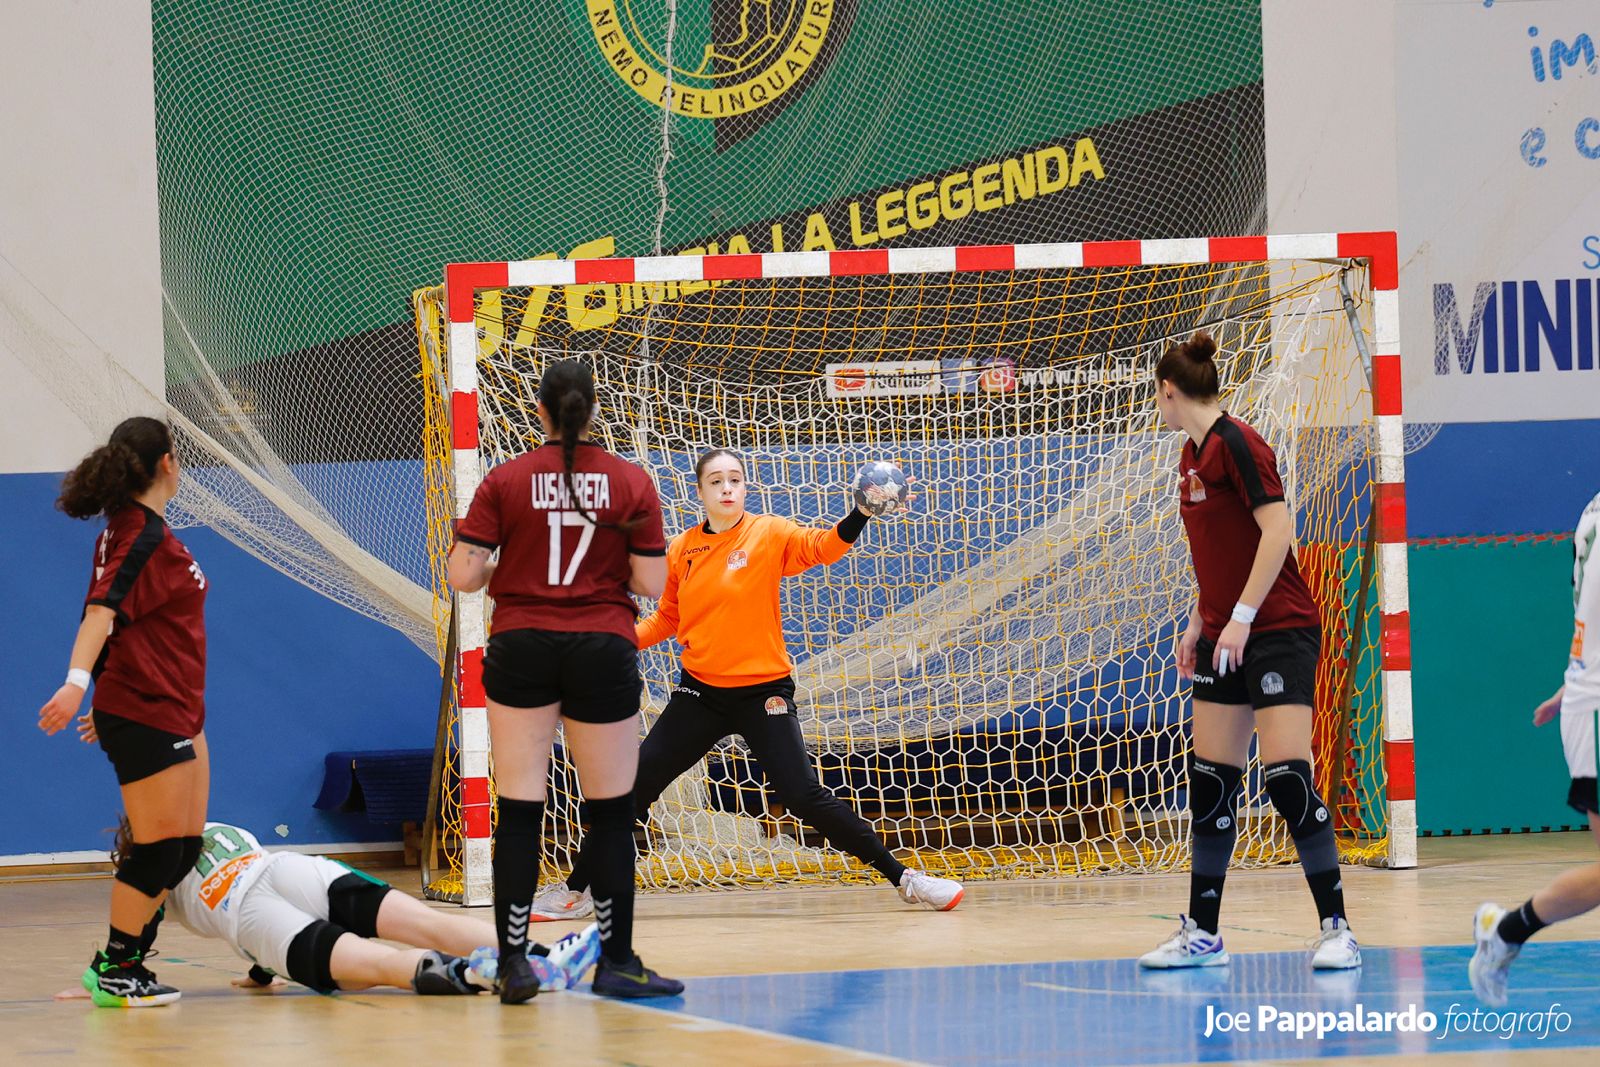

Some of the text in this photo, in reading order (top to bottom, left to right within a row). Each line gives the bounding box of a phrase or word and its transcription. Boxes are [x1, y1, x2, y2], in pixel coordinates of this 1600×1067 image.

[593, 8, 648, 88] NEMO
[848, 137, 1106, 247] LEGGENDA
[1433, 278, 1600, 376] MINI
[546, 511, 597, 586] 17
